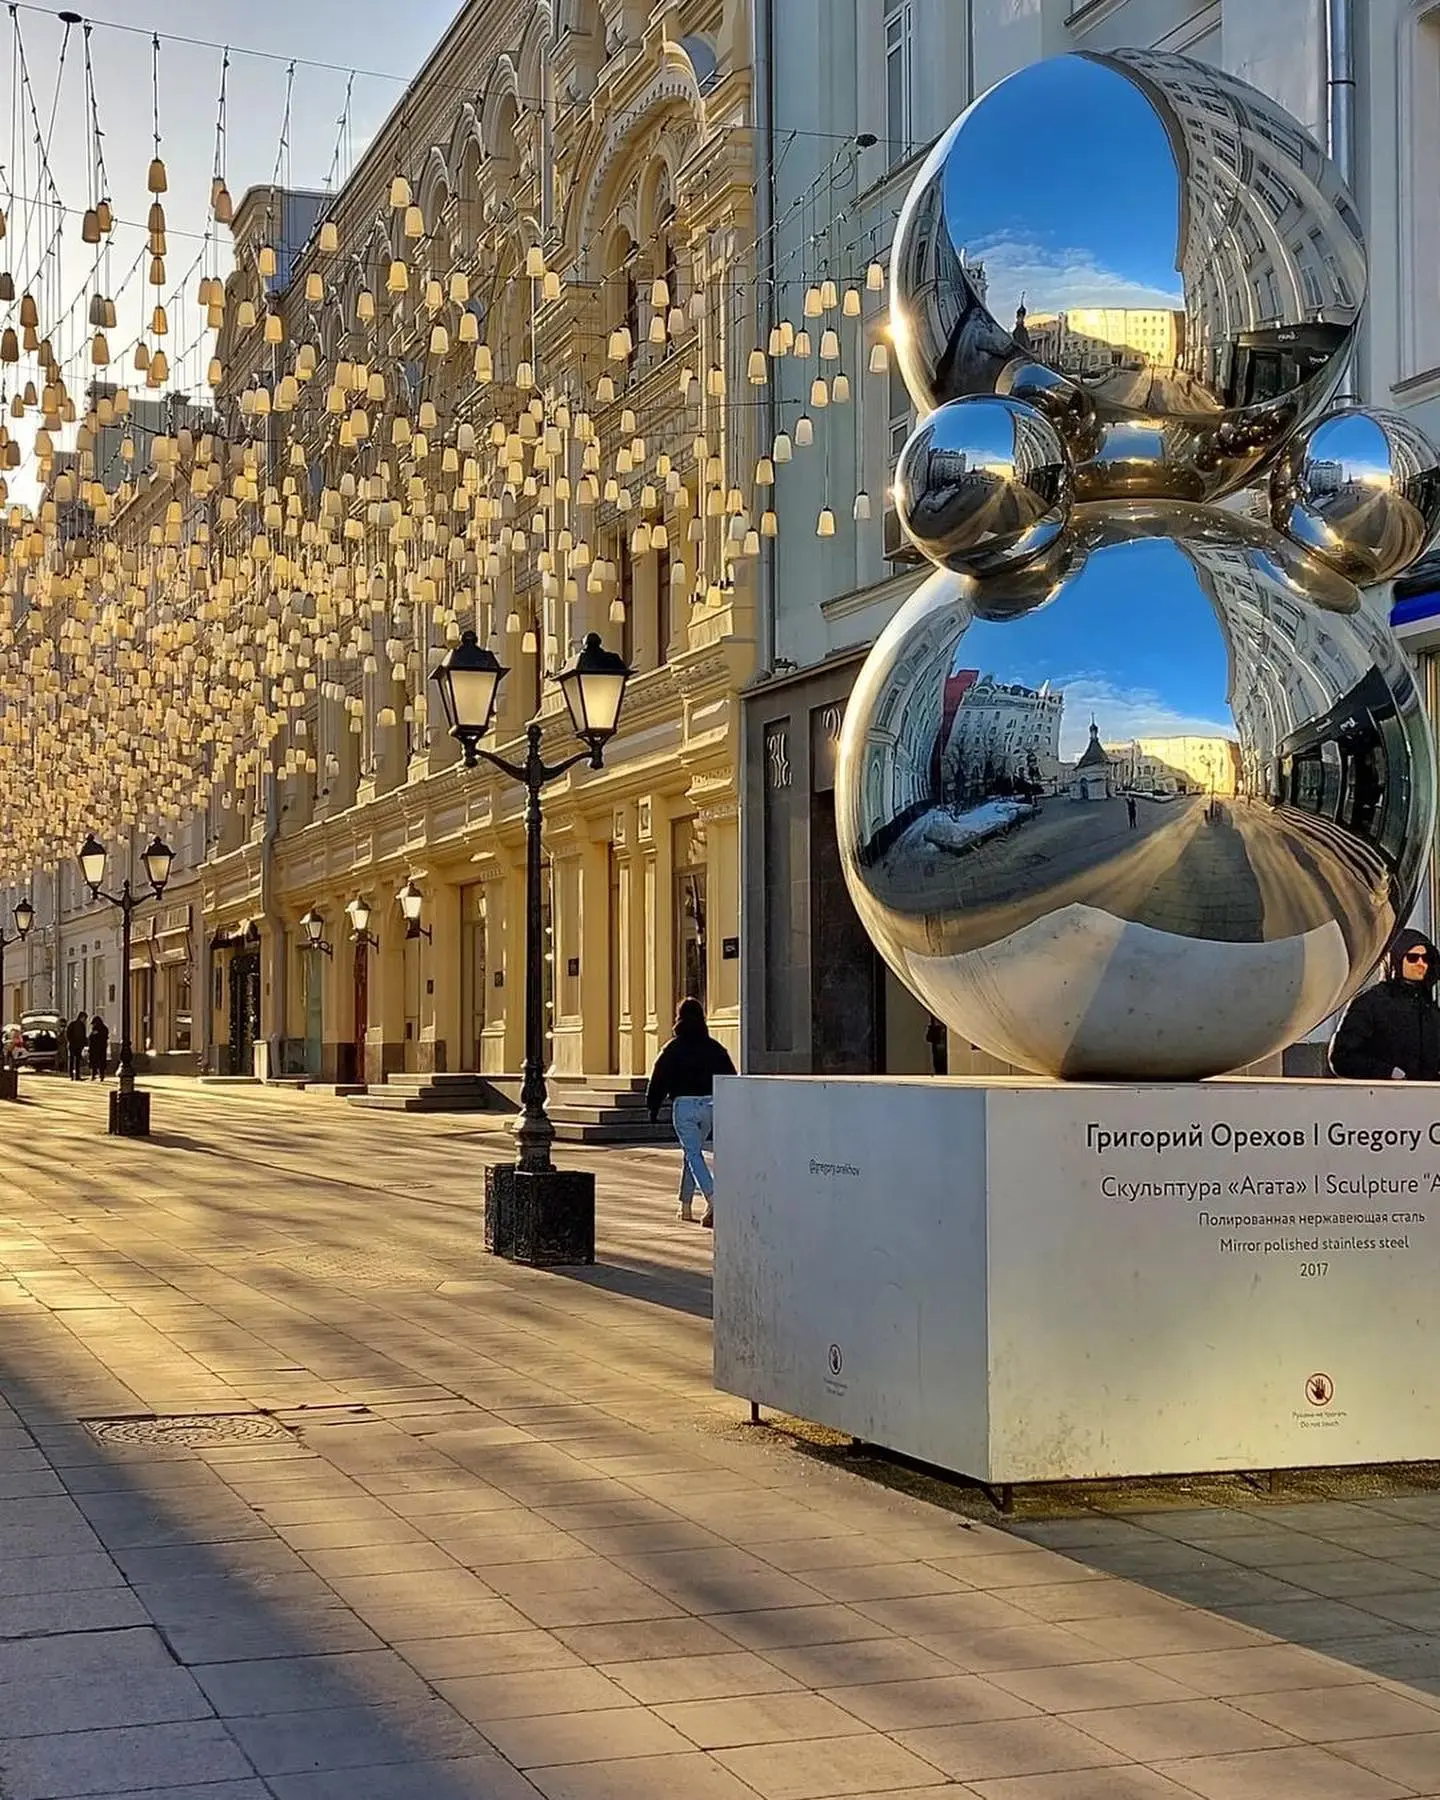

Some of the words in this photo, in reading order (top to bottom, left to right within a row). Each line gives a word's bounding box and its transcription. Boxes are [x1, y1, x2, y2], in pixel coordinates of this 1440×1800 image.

[1086, 1122, 1203, 1153] Григорий
[1211, 1122, 1305, 1152] Орехов
[1327, 1122, 1422, 1152] Gregory
[1101, 1176, 1222, 1201] Скульптура
[1227, 1175, 1307, 1196] «Агата»
[1326, 1173, 1419, 1200] Sculpture
[1198, 1212, 1296, 1229] Полированная
[1298, 1212, 1389, 1228] нержавеющая
[1391, 1212, 1426, 1223] сталь
[1220, 1238, 1262, 1253] Mirror
[1264, 1236, 1319, 1255] polished
[1322, 1236, 1377, 1250] stainless
[1378, 1234, 1410, 1249] steel
[1300, 1262, 1329, 1277] 2017
